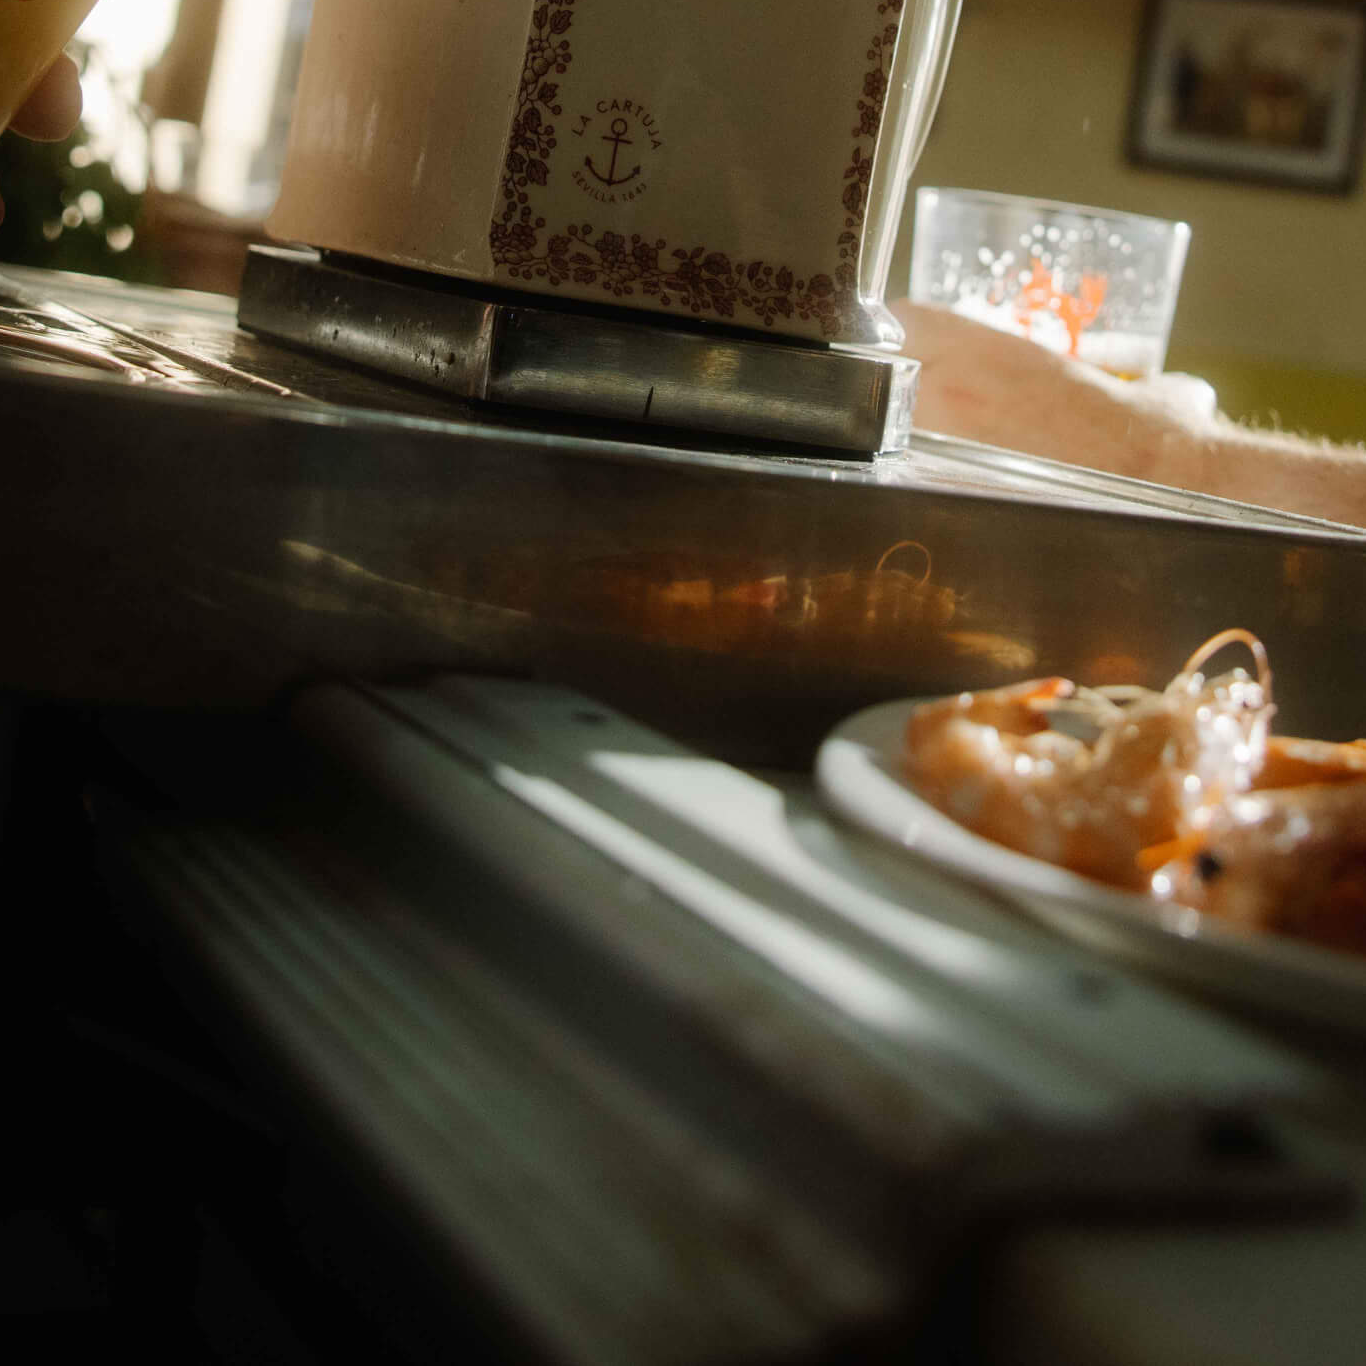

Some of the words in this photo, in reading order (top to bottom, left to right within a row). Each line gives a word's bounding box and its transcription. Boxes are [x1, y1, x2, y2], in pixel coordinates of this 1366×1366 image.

[572, 115, 592, 137] LA
[596, 98, 662, 150] CARTUJA
[572, 170, 616, 203] SEVILLA
